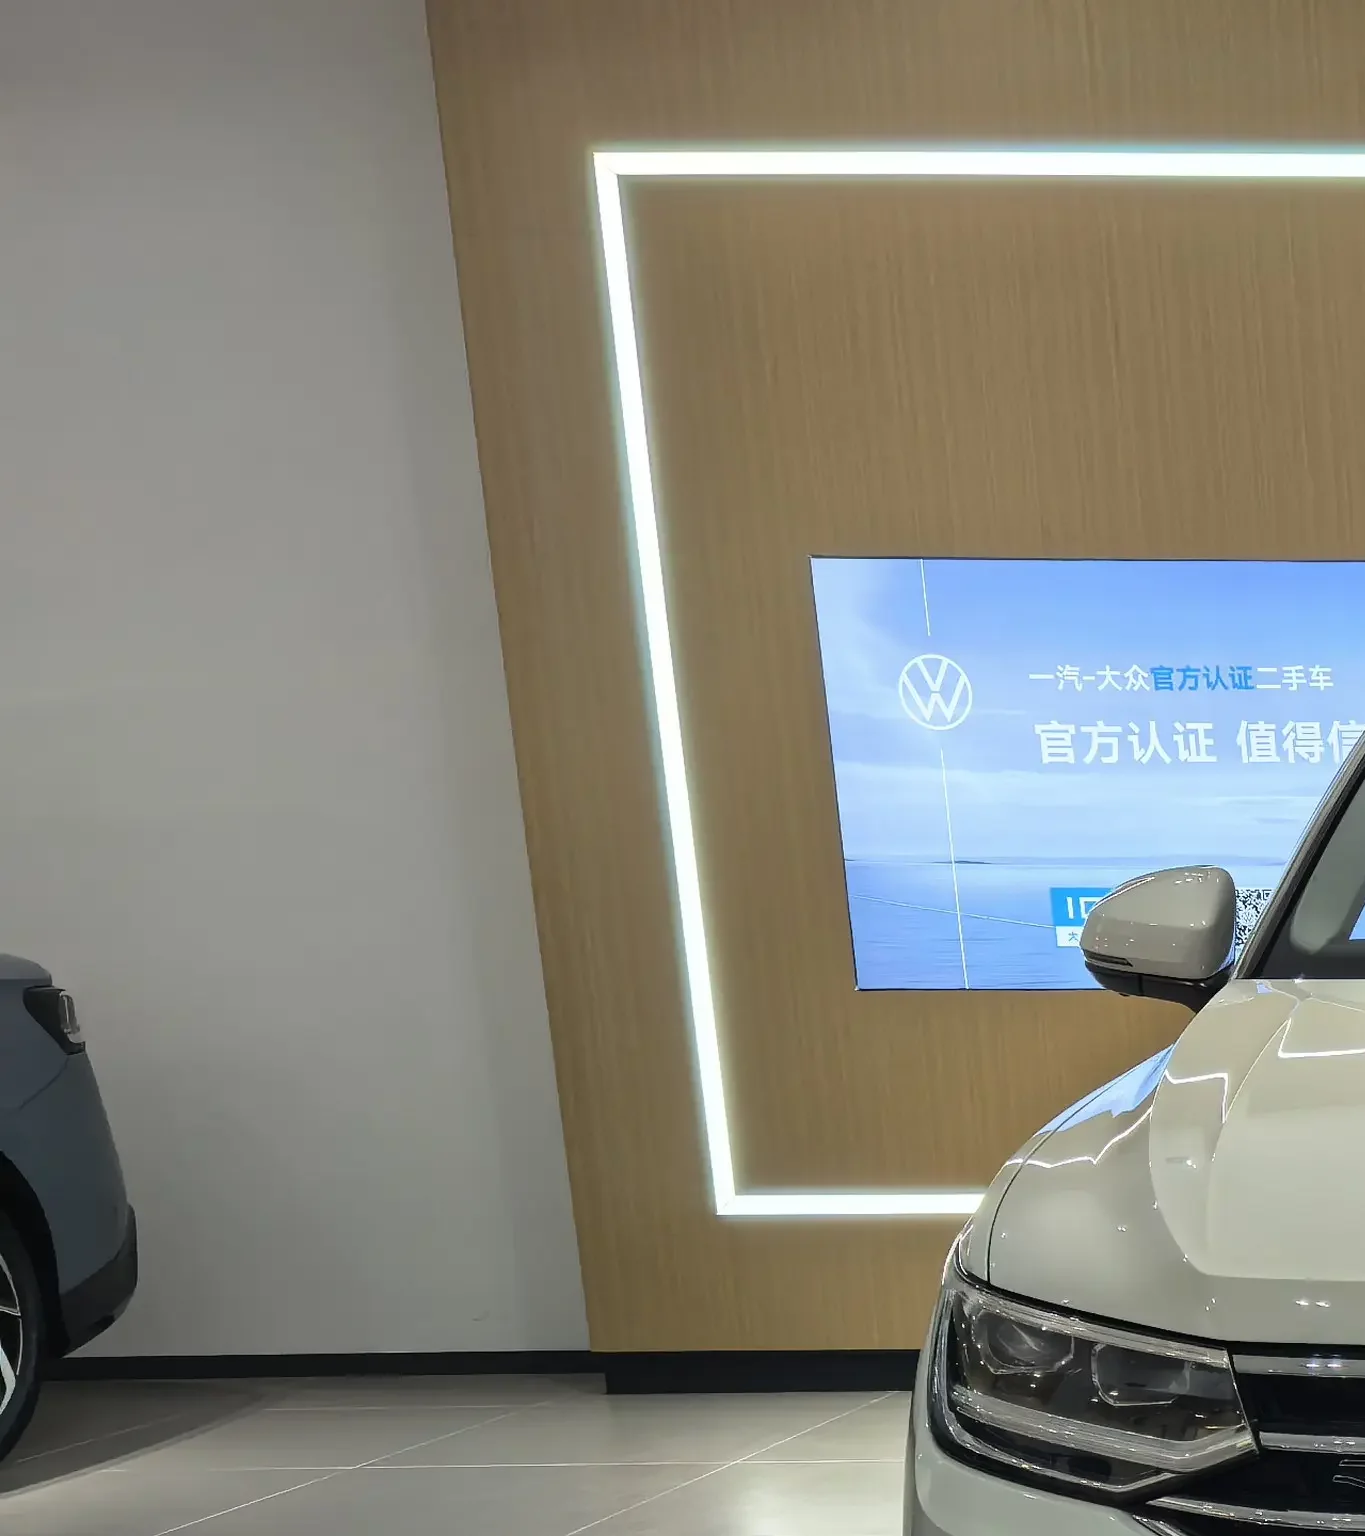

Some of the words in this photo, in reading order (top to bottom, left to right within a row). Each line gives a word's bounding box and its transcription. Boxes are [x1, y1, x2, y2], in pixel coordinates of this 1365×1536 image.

[1028, 664, 1334, 692] 一汽-大众官方认证二手车
[1034, 719, 1218, 764] 官方认证
